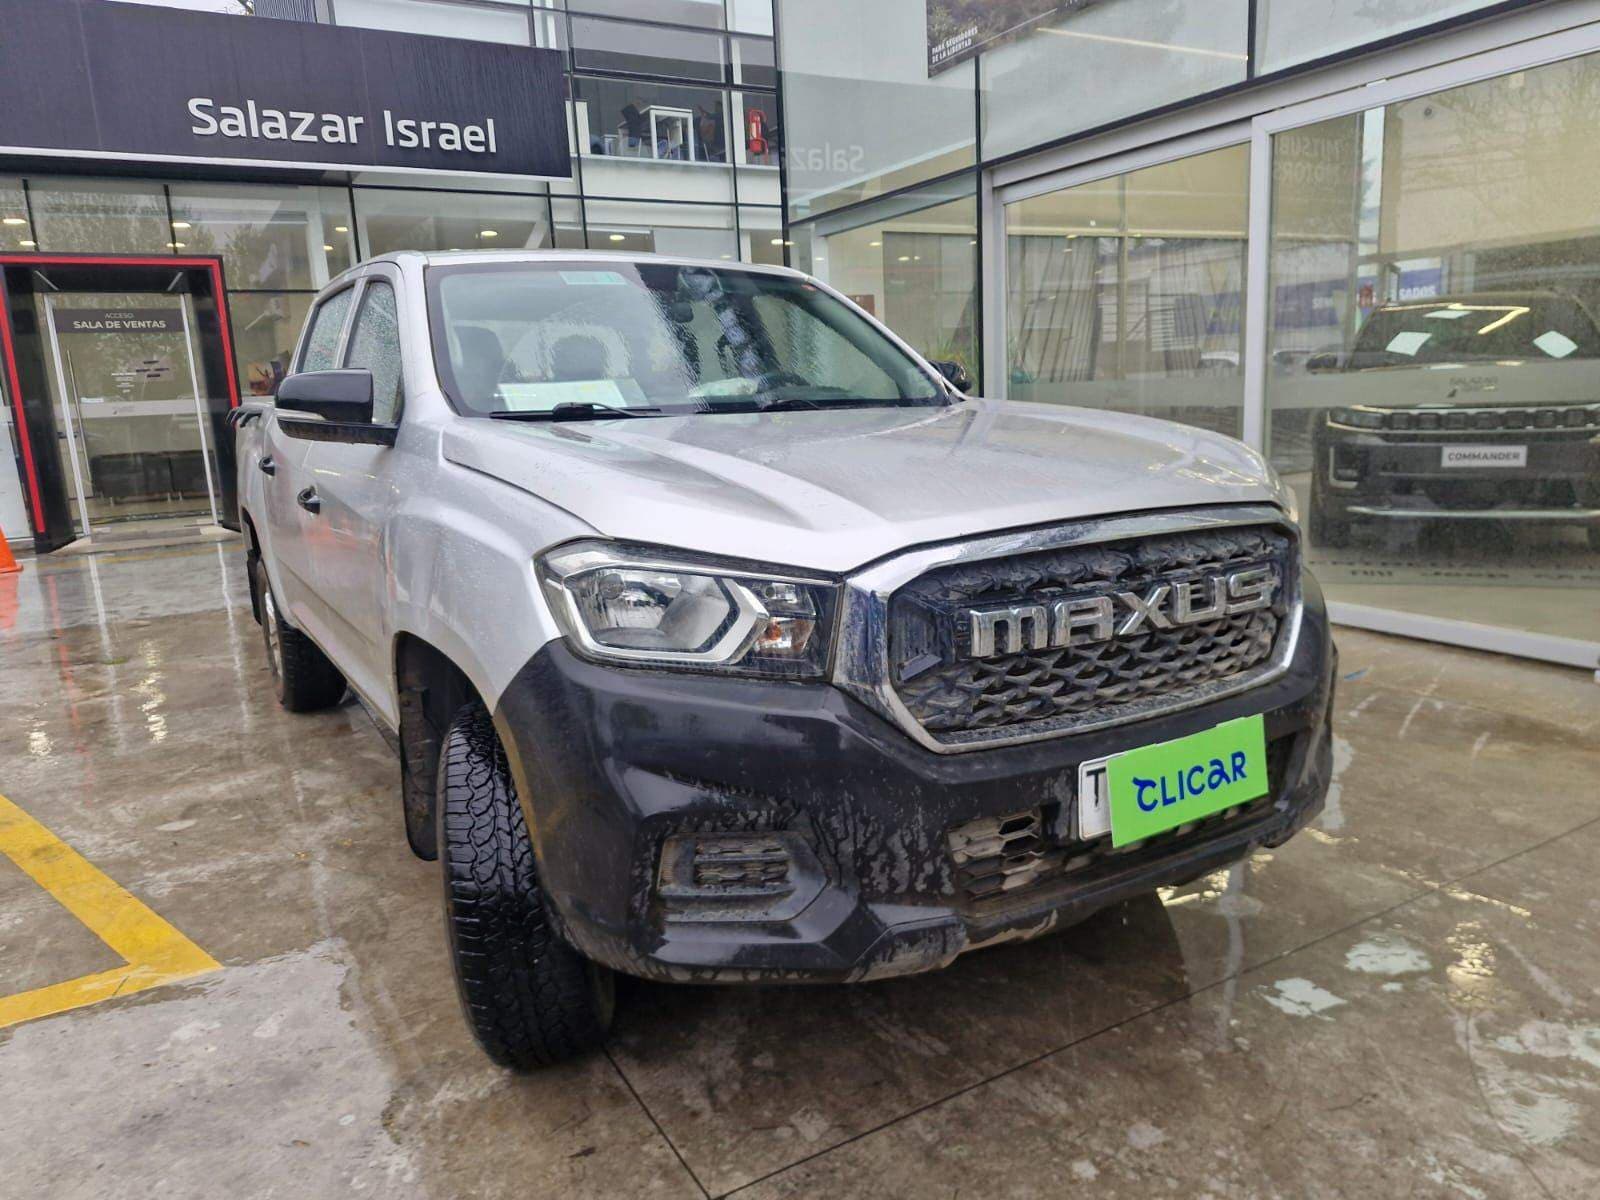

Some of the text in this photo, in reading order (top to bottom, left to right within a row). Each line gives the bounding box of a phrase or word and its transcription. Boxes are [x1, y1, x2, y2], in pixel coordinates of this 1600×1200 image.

[931, 54, 939, 63] DE
[940, 50, 946, 60] LA
[187, 97, 497, 153] Salazar Israel
[73, 320, 166, 329] SALA DE VENTAS
[1447, 450, 1521, 462] COMMANDER
[969, 566, 1278, 658] MAXUS
